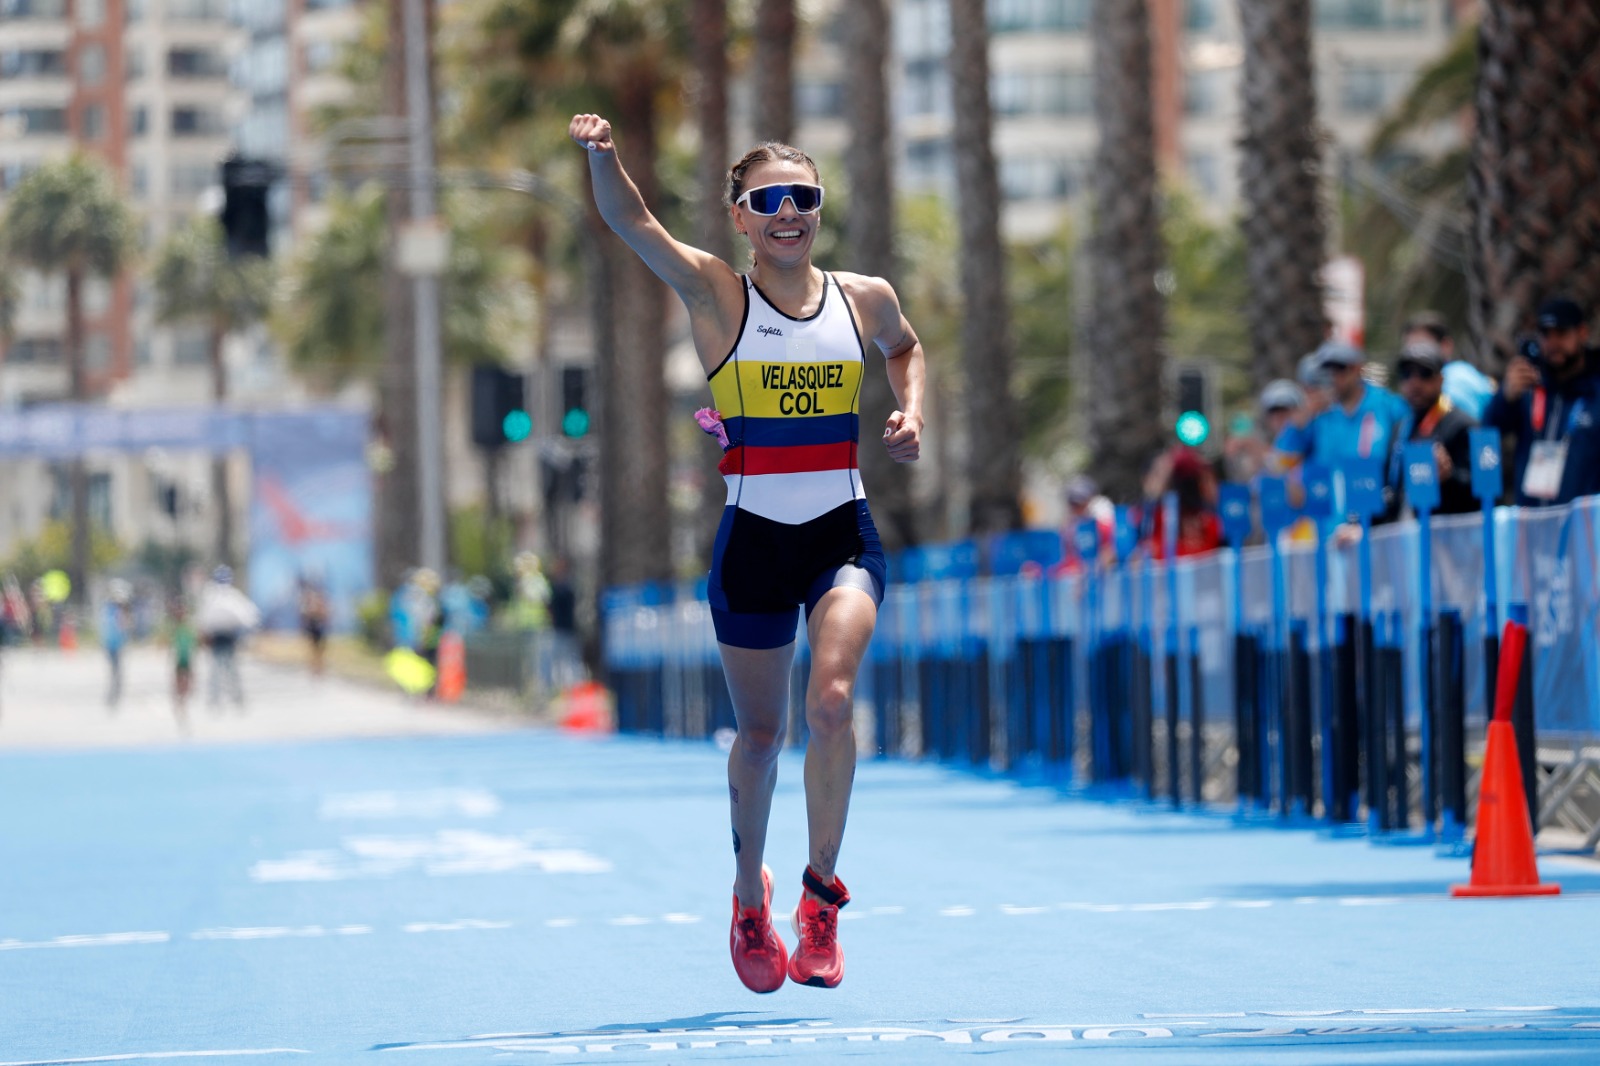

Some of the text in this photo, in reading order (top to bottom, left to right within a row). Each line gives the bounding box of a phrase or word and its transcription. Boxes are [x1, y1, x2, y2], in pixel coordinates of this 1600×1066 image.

[757, 325, 783, 337] Safetti
[761, 364, 843, 390] VELASQUEZ
[779, 392, 825, 416] COL
